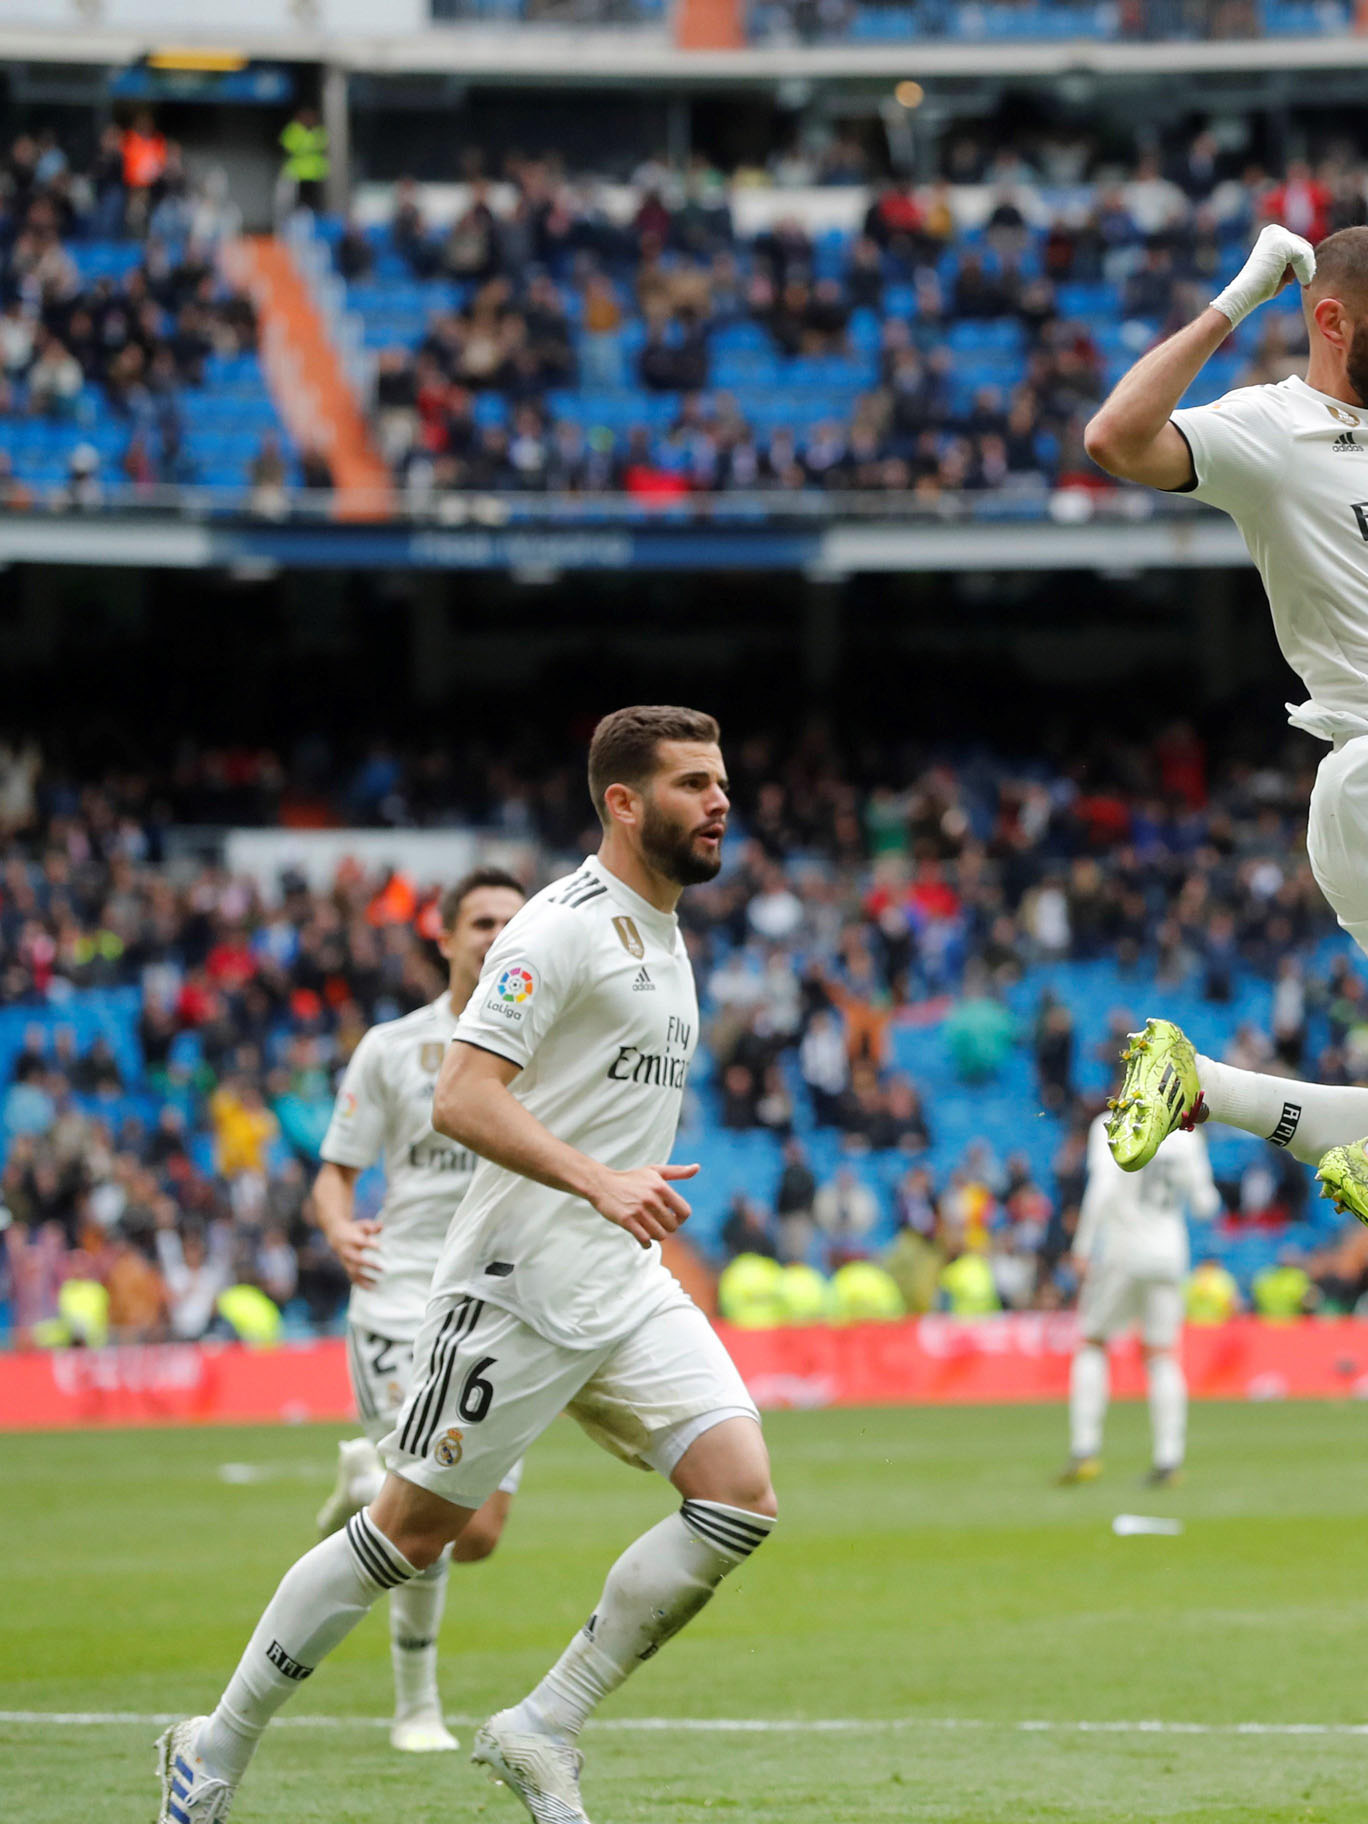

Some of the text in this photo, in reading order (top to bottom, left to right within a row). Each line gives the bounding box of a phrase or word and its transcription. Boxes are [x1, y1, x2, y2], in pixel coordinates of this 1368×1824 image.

[1332, 441, 1364, 452] adidas
[487, 1000, 522, 1021] LaLiga
[667, 1016, 690, 1050] Fly
[607, 1046, 689, 1089] Emira
[458, 1356, 498, 1424] 6
